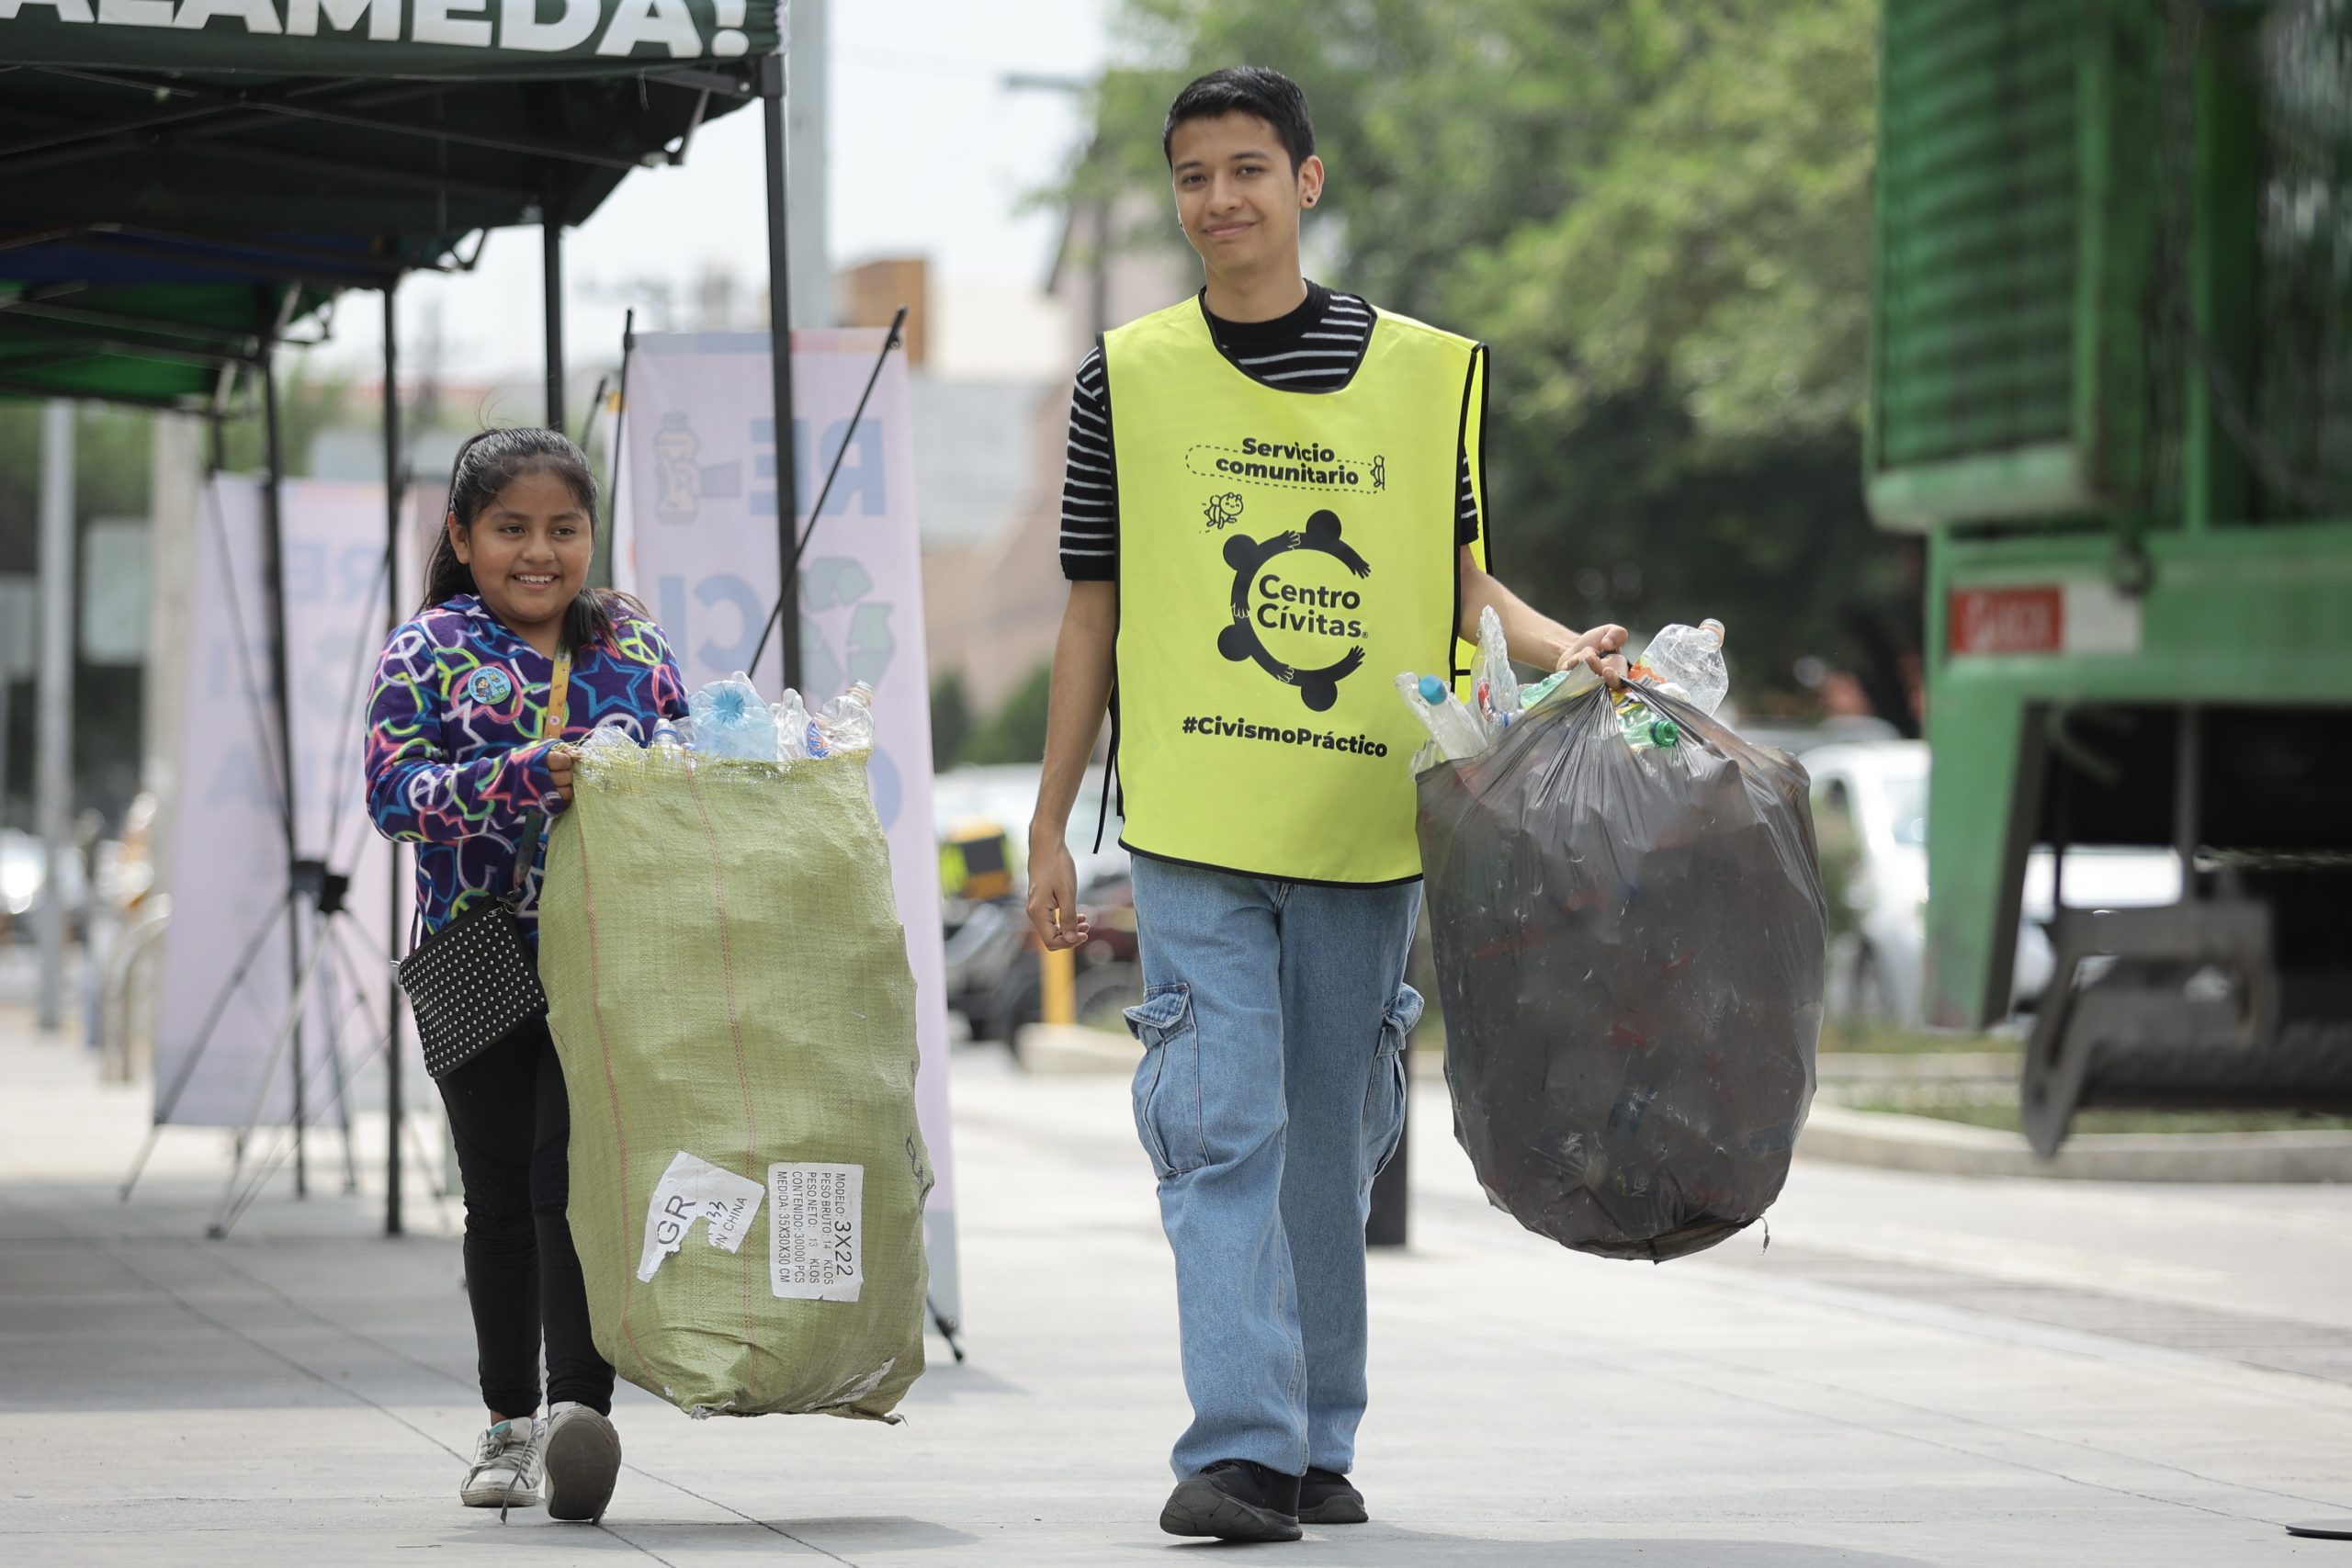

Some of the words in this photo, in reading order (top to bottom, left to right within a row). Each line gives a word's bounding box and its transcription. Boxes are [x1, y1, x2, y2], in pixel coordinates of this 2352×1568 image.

[0, 0, 750, 58] EDA!
[1241, 436, 1336, 463] Servicio
[1216, 457, 1359, 485] comunitario
[1259, 573, 1361, 610] Centro
[1182, 716, 1388, 758] #CivismoPráctico
[776, 1171, 789, 1211] MEDIDA:
[792, 1171, 804, 1231] CONTENIDO:
[807, 1171, 818, 1197] PESO
[820, 1172, 831, 1199] PESO
[835, 1173, 846, 1218] MODELO:
[657, 1194, 696, 1245] GR
[723, 1197, 748, 1232] CHINA
[808, 1199, 819, 1228] NETO:
[821, 1201, 832, 1236] BRUTO:
[778, 1213, 791, 1265] 35X30X30
[794, 1233, 805, 1263] 30000
[808, 1237, 819, 1247] 13
[822, 1239, 832, 1249] 14
[834, 1221, 854, 1277] 3X22
[779, 1268, 790, 1283] CM
[795, 1265, 806, 1283] PCS
